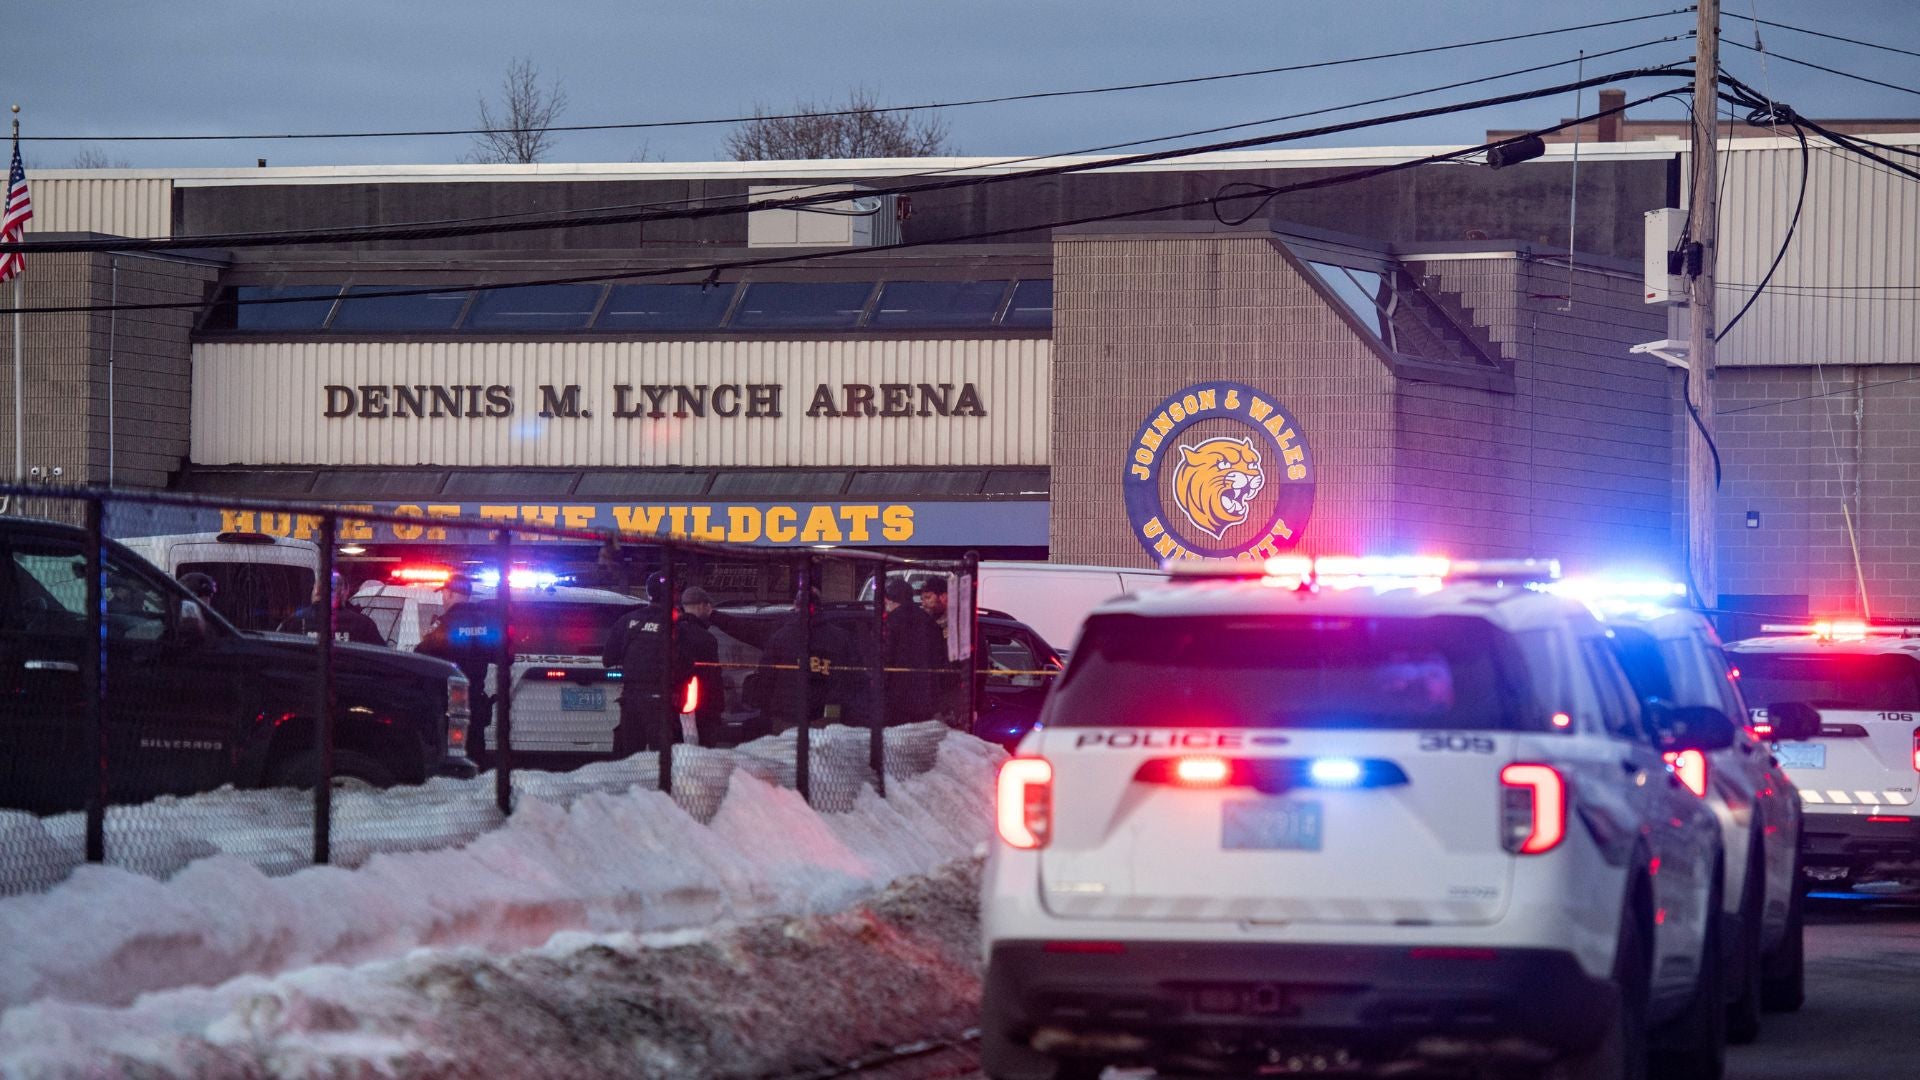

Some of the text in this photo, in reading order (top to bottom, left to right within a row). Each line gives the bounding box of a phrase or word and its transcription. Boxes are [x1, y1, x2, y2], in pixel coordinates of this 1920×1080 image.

[323, 382, 987, 419] DENNIS M. LYNCH ARENA
[1132, 388, 1307, 481] JOHNSON & WALES
[391, 504, 461, 540] OF
[479, 505, 596, 541] THE
[612, 505, 915, 542] WILDCATS
[459, 626, 488, 636] POLICE
[514, 654, 574, 664] OLICE
[798, 656, 831, 676] BI
[1877, 711, 1913, 722] 106
[140, 738, 222, 750] SILVERADO
[1076, 732, 1242, 749] POLICE
[1419, 732, 1497, 755] 309
